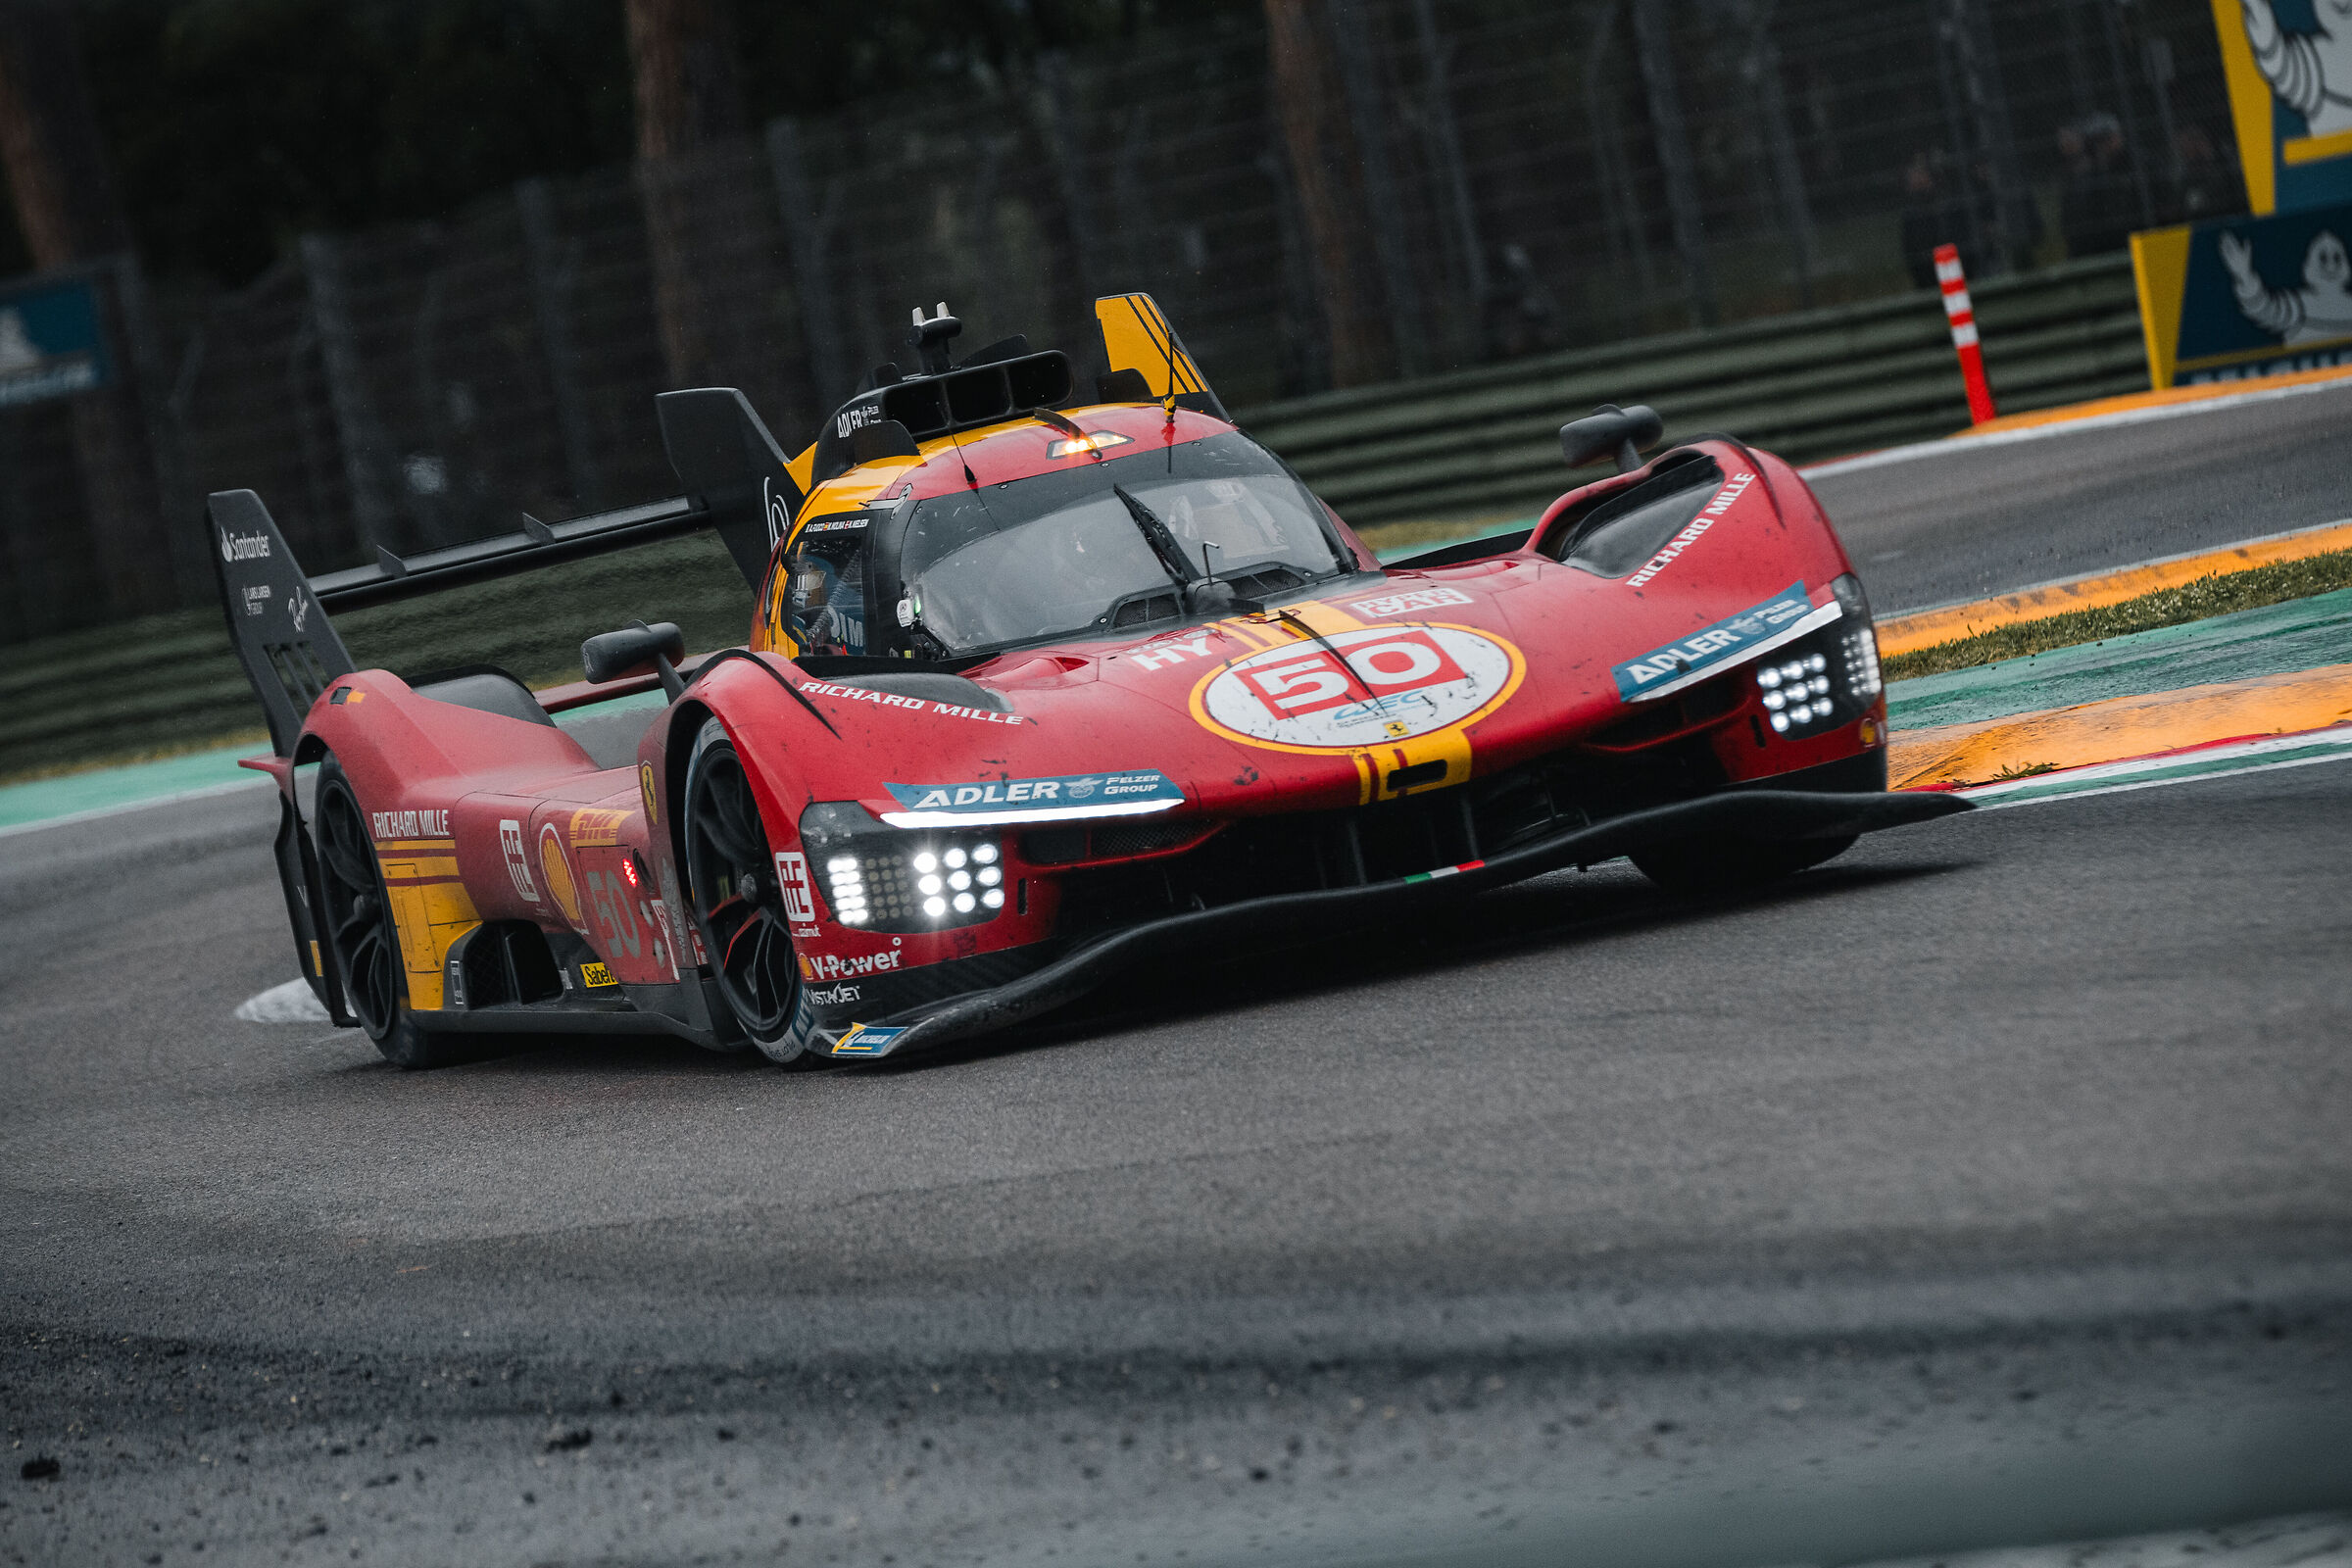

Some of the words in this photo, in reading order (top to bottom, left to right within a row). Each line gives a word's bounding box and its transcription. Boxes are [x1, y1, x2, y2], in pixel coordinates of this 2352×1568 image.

[1626, 516, 1715, 588] RICHARD
[1713, 471, 1757, 515] MILLE
[229, 530, 270, 561] Santander
[1368, 594, 1464, 615] CAR
[1626, 629, 1742, 685] ADLER
[1250, 640, 1443, 711] 50
[799, 681, 925, 710] RICHARD
[933, 703, 1024, 725] MILLE
[1103, 784, 1158, 795] GROUP
[1105, 774, 1160, 785] PELZER
[912, 781, 1060, 809] ADLER
[372, 810, 418, 838] RICHARD
[418, 809, 450, 836] MILLE
[586, 870, 641, 958] 50
[810, 950, 902, 980] V-Power
